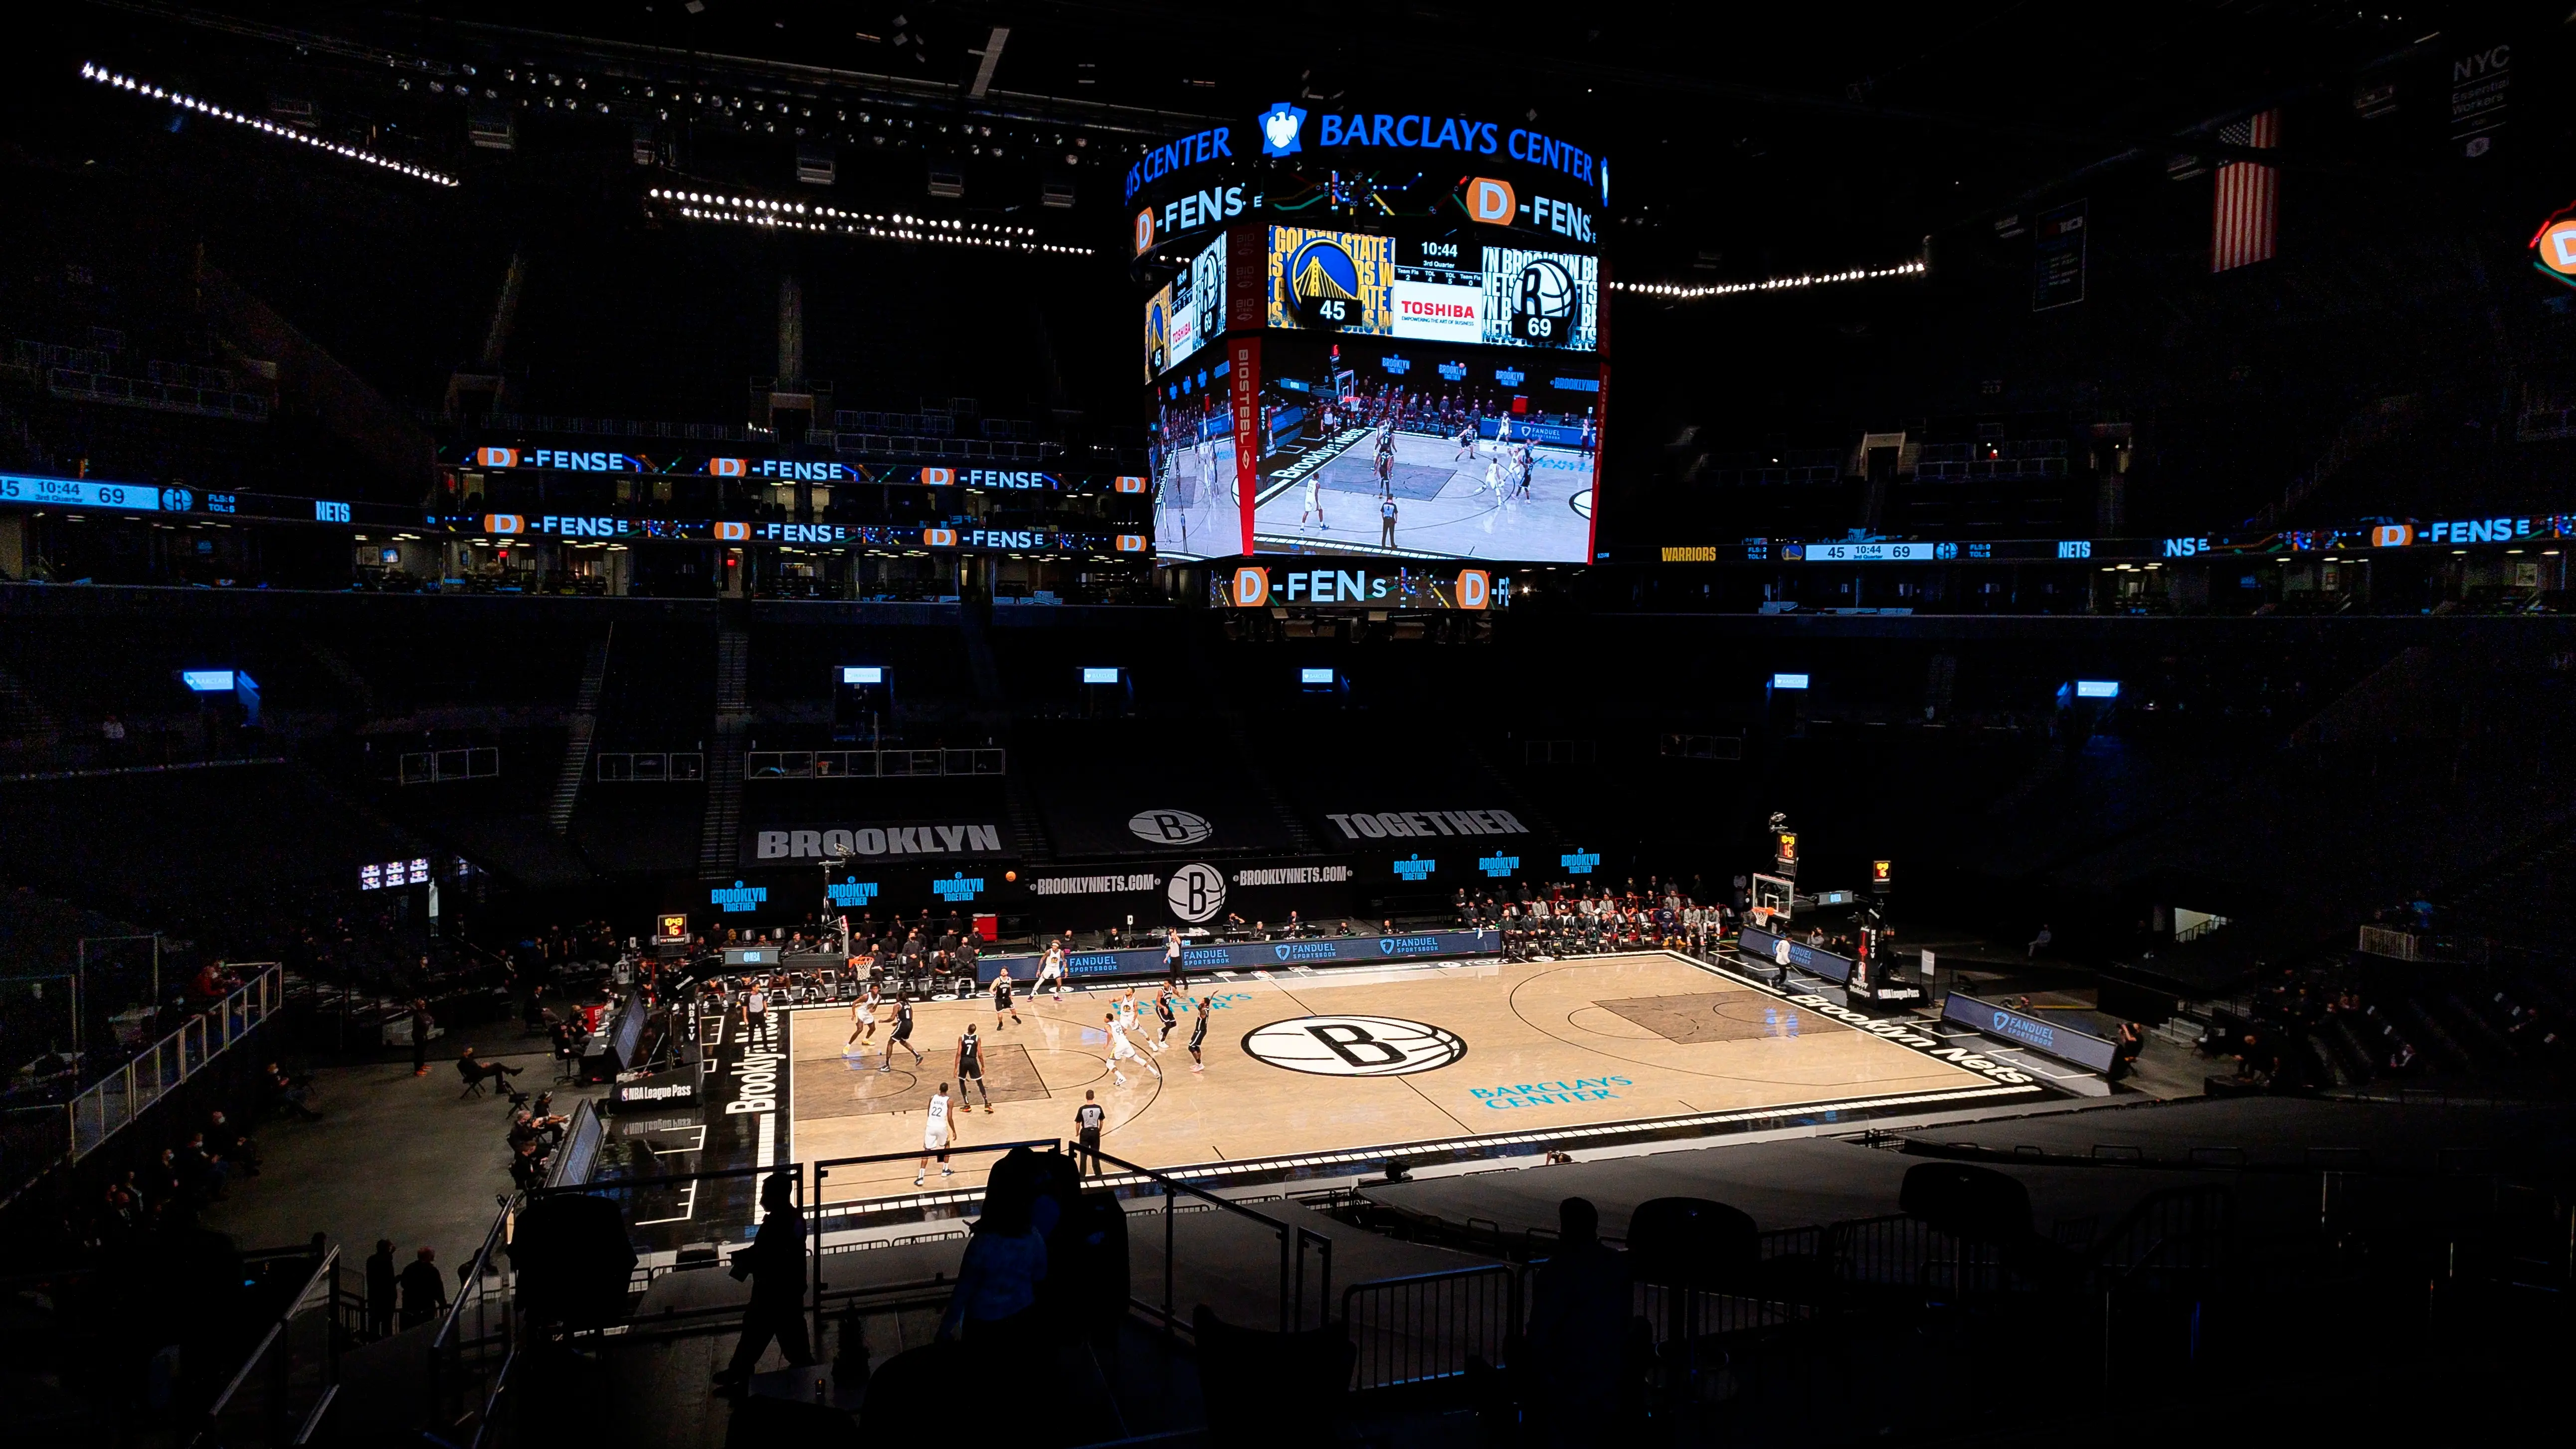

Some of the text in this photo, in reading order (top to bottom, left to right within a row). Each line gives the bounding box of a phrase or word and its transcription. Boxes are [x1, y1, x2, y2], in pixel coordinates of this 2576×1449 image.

[2453, 45, 2510, 81] NYC
[1144, 127, 1232, 183] CENTER
[1320, 115, 1594, 186] BARCLAYS CENTER
[1422, 241, 1458, 257] 10:44
[1320, 300, 1345, 320] 45
[1401, 300, 1475, 319] TOSHIBA
[1204, 311, 1212, 333] 69
[1528, 317, 1551, 337] 69
[1173, 321, 1191, 344] TOSHIBA
[1154, 349, 1161, 367] 45
[1495, 370, 1524, 382] BROOKLYN
[1238, 349, 1251, 444] BIOSTEEL
[1532, 427, 1560, 436] FANDUEL
[38, 481, 80, 495] 10:44
[99, 487, 125, 504] 69
[316, 501, 351, 522] NETS
[1661, 546, 1716, 561] WARRIORS
[1828, 546, 1845, 558] 45
[1855, 545, 1881, 554] 10:44
[1893, 546, 1911, 558] 69
[2058, 541, 2090, 558] NETS
[1326, 810, 1530, 839] TOGETHER
[757, 825, 1001, 859] BROOKLYN
[1784, 844, 1793, 858] 16
[1394, 859, 1436, 874] BROOKLYN
[1479, 856, 1519, 872] BROOKLYN
[1561, 853, 1600, 868] BROOKLYN
[1240, 866, 1346, 887] BROOKLYNNETS.COM
[1402, 871, 1427, 881] TOGETHER
[1487, 868, 1511, 877] TOGETHER
[1569, 865, 1592, 875] TOGETHER
[933, 878, 984, 894] BROOKLYN
[1037, 874, 1154, 895] BROOKLYNNETS.COM
[711, 888, 767, 904] BROOKLYN
[836, 896, 868, 907] TOGETHER
[943, 892, 974, 902] TOGETHER
[723, 902, 756, 912] TOGETHER
[1291, 943, 1336, 954] FANDUEL
[1396, 937, 1438, 947] FANDUEL
[1396, 944, 1439, 953] SPORTSBOOK
[743, 951, 760, 962] @NBA
[1069, 955, 1117, 967] FANDUEL
[1184, 949, 1229, 960] FANDUEL
[1184, 957, 1230, 966] SPORTSBOOK
[1292, 950, 1336, 959] SPORTSBOOK
[2010, 1017, 2054, 1040] FANDUEL
[1792, 994, 2034, 1084] Brooklyn Nets
[2008, 1027, 2053, 1047] SPORTSBOOK
[966, 1045, 972, 1055] 7
[629, 1084, 691, 1101] NBA League Pass
[1469, 1076, 1634, 1100] BARCLAYS
[1484, 1088, 1622, 1110] CENTER
[931, 1106, 942, 1117] 22
